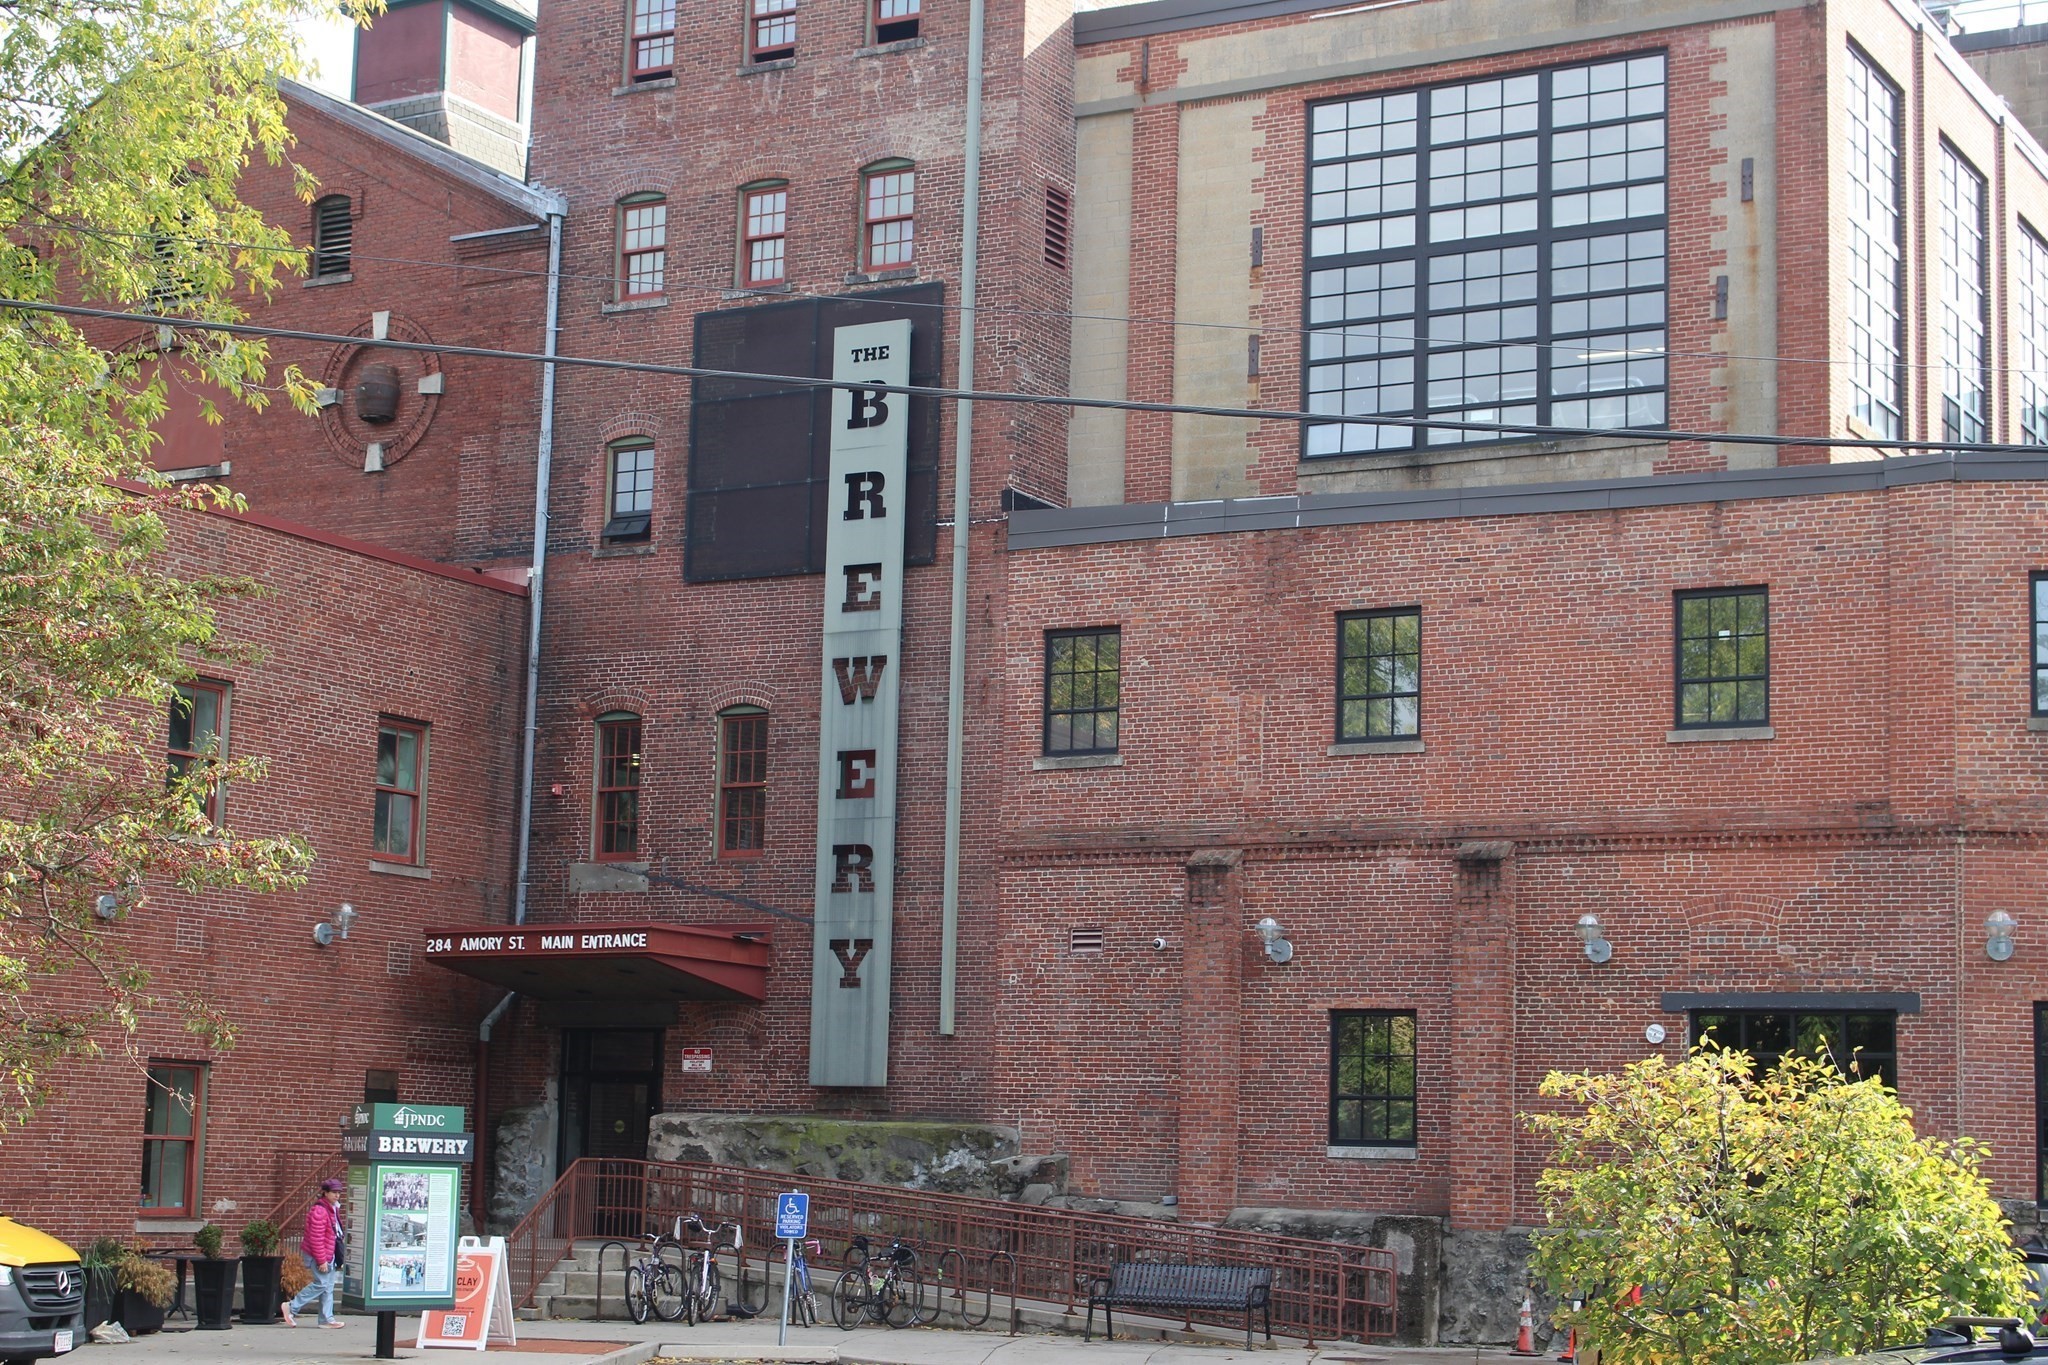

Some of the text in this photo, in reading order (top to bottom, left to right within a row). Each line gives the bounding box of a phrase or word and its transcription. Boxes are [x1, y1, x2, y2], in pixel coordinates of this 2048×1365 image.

[851, 345, 890, 363] THE
[829, 379, 889, 989] BREWERY
[426, 933, 647, 953] 284 AMORY ST. MAIN ENTRANCE
[403, 1113, 445, 1128] JPNDC
[378, 1136, 468, 1155] BREWERY
[457, 1277, 478, 1286] CLAY
